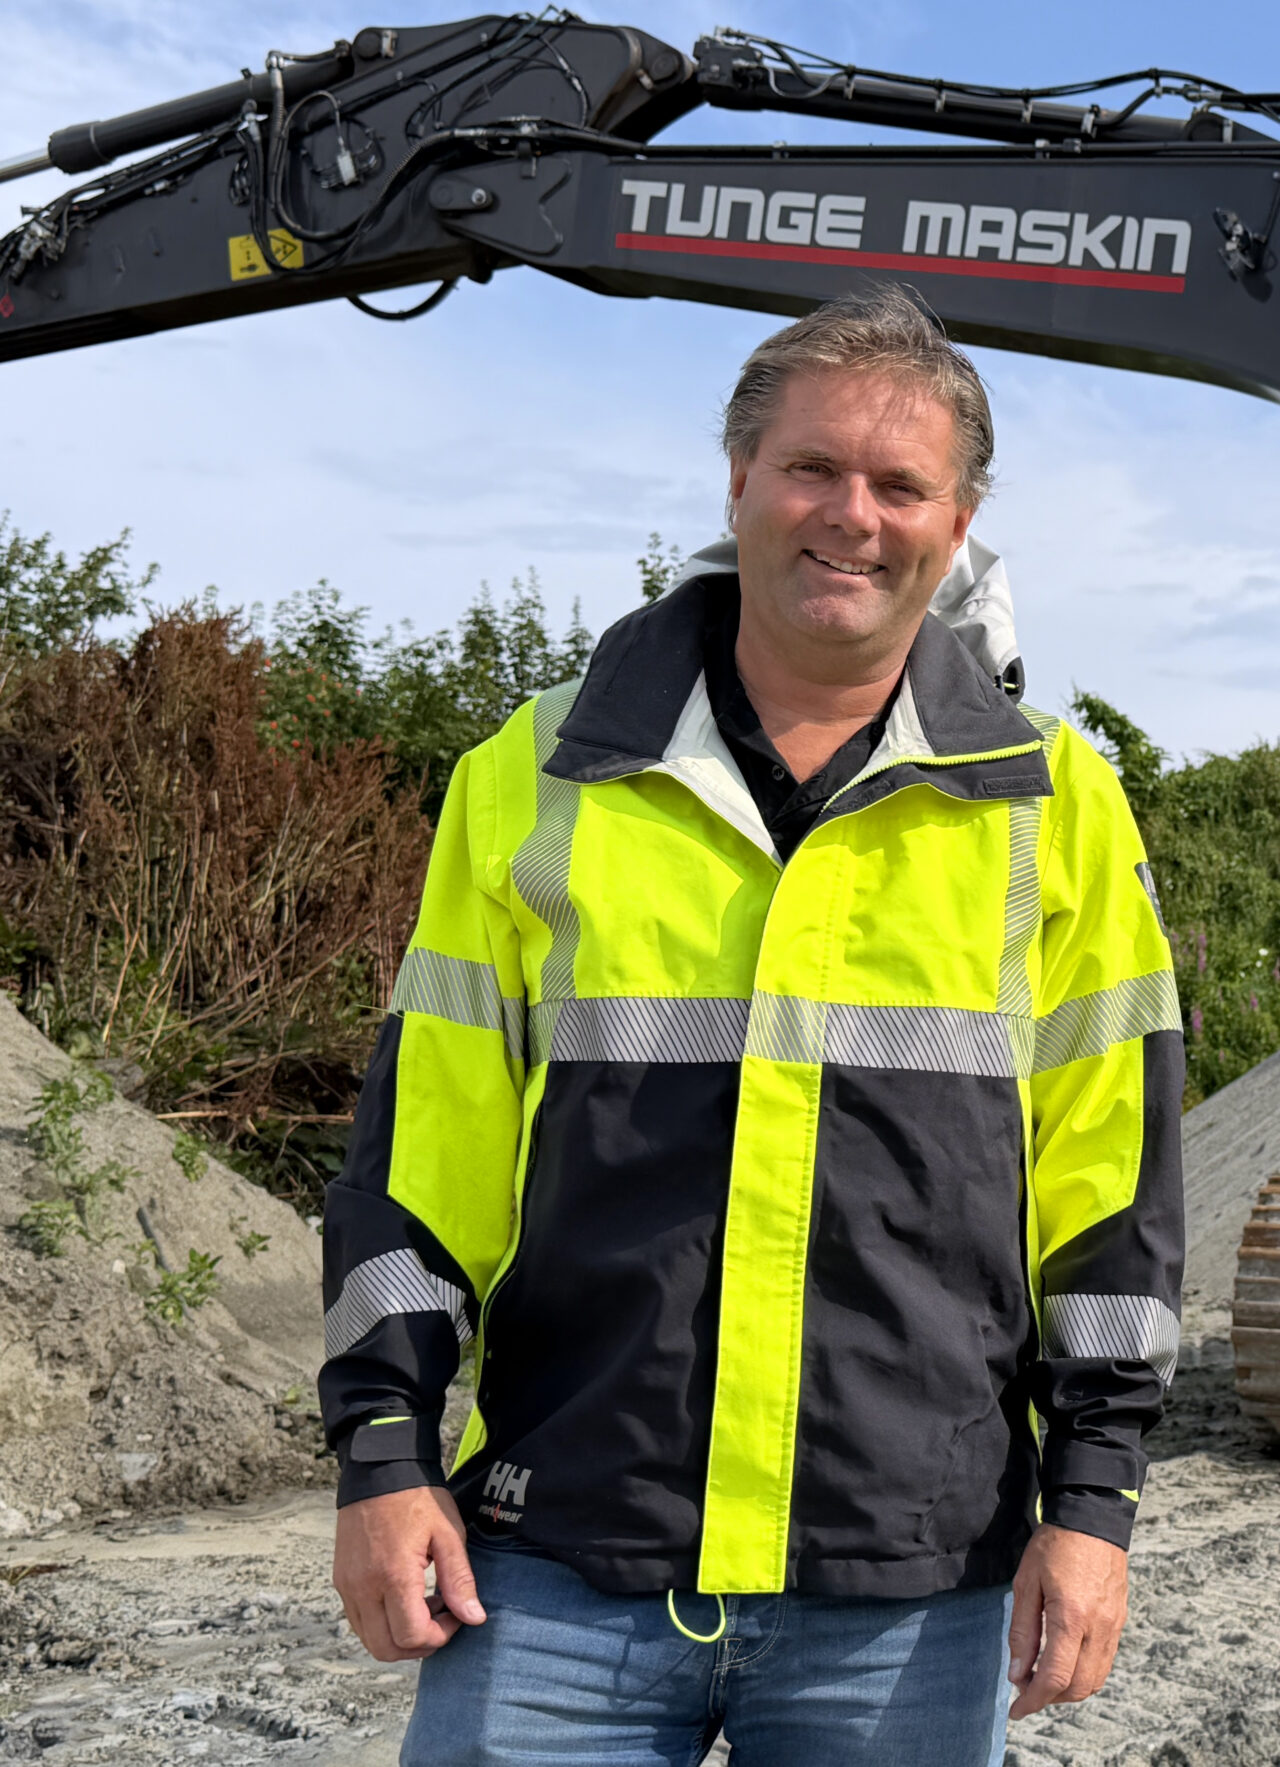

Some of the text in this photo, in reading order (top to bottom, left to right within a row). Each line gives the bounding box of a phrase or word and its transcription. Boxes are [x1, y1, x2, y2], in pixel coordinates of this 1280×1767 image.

[622, 179, 1192, 275] TUNGE MASKIN
[483, 1460, 532, 1506] HH
